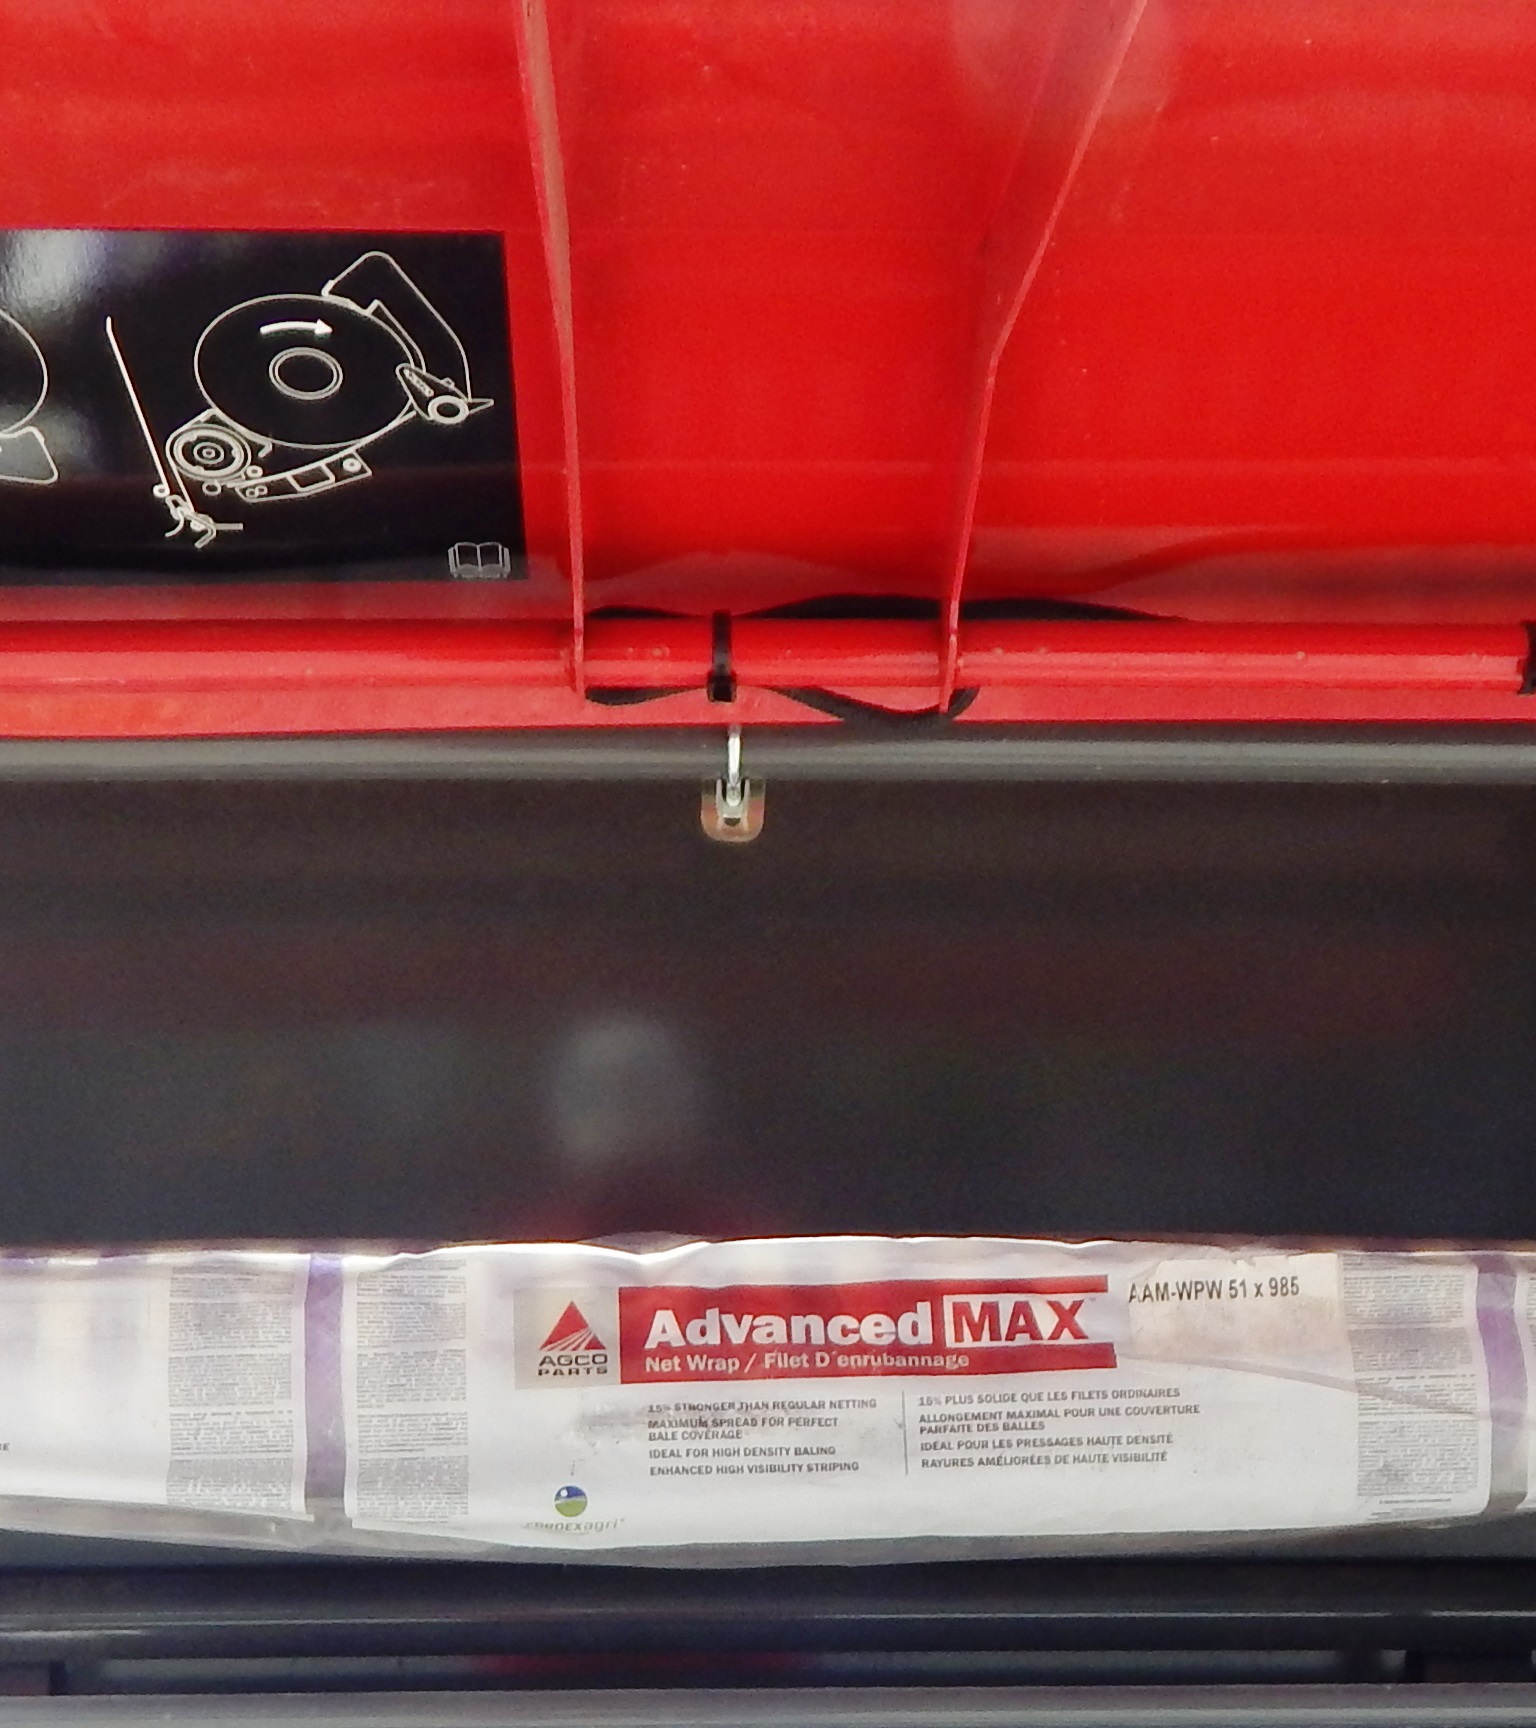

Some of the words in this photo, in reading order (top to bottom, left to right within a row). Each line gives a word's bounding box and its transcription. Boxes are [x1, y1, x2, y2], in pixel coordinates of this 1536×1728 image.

[1129, 1279, 1223, 1304] AAM-WPW
[1228, 1279, 1247, 1299] 51
[1268, 1276, 1300, 1297] 985
[644, 1301, 933, 1349] Advanced
[952, 1299, 1090, 1344] MAX
[539, 1353, 608, 1367] AGCO
[645, 1355, 682, 1373] Net
[686, 1354, 741, 1376] Wrap
[763, 1351, 809, 1370] Filet
[538, 1366, 608, 1376] PARTS
[945, 1395, 974, 1405] PLUS
[977, 1393, 1017, 1404] SOLIDE
[1021, 1392, 1043, 1403] QUE
[1047, 1392, 1068, 1402] LES
[1071, 1390, 1108, 1400] FILETS
[1111, 1388, 1180, 1399] ORDINAIRES
[674, 1402, 736, 1412] STRONGER
[737, 1401, 770, 1412] THAN
[772, 1400, 826, 1410] REGULAR
[829, 1399, 877, 1409] NETTING
[919, 1412, 1002, 1423] ALLONGEMENT
[1006, 1409, 1060, 1421] MAXIMAL
[1064, 1408, 1096, 1418] POUR
[1099, 1407, 1121, 1417] UNE
[1125, 1404, 1200, 1416] COUVERTURE
[648, 1418, 708, 1429] MAXIMUM
[711, 1418, 758, 1428] SPREAD
[761, 1417, 785, 1427] FOR
[788, 1417, 838, 1427] PERFECT
[920, 1423, 973, 1434] PARFAITE
[977, 1422, 1000, 1432] DES
[1002, 1420, 1046, 1431] BALLES
[648, 1431, 678, 1442] BALE
[681, 1429, 743, 1441] COVERAGE
[957, 1440, 989, 1450] POUR
[992, 1439, 1014, 1449] LES
[1016, 1436, 1083, 1448] PRESSAGES
[1086, 1435, 1123, 1446] HAUTE
[649, 1448, 682, 1459] IDEAL
[685, 1448, 709, 1458] FOR
[712, 1447, 741, 1457] HIGH
[743, 1447, 791, 1457] DENSITY
[794, 1446, 836, 1456] BALING
[921, 1457, 974, 1468] RAYURES
[1054, 1455, 1070, 1465] DE
[1072, 1453, 1110, 1464] HAUTE
[649, 1465, 713, 1476] ENHANCED
[716, 1464, 745, 1475] HIGH
[747, 1463, 803, 1474] VISIBILITY
[806, 1461, 859, 1472] STRIPING
